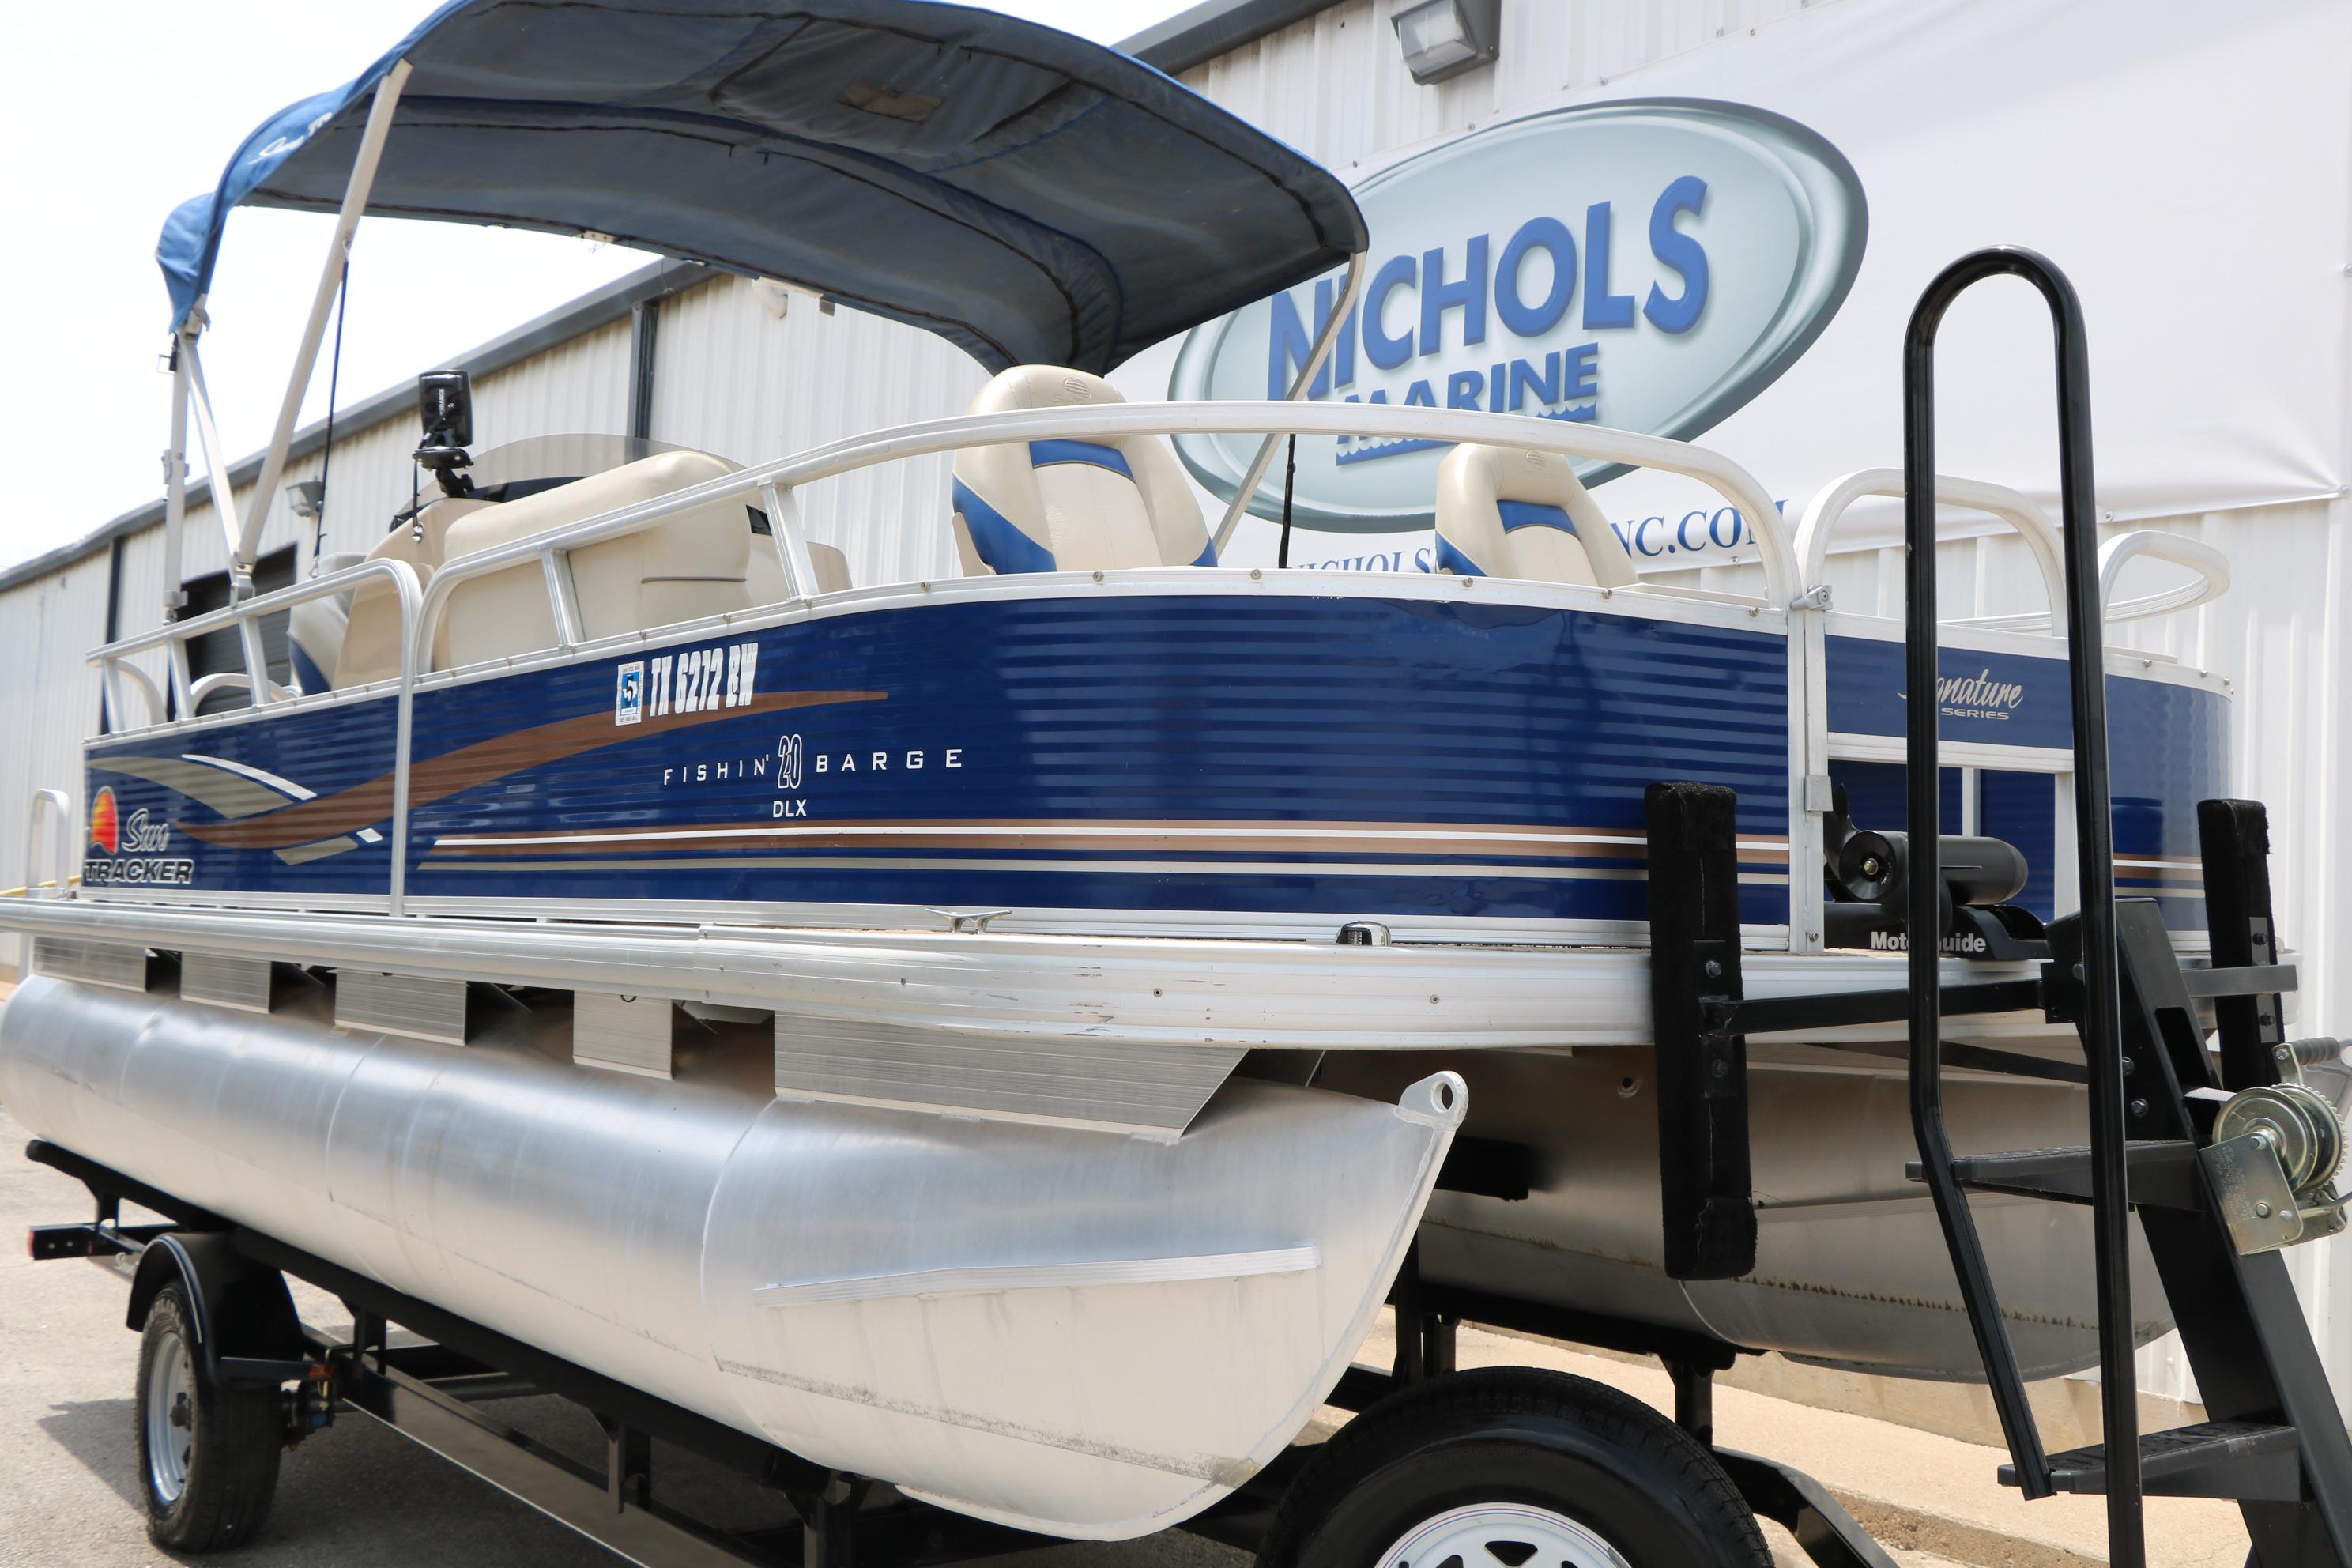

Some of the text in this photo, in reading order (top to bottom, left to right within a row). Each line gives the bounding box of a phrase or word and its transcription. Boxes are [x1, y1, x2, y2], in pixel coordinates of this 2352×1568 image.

[1267, 175, 1709, 401] NICHOLS
[650, 655, 673, 717] TX
[674, 647, 723, 714] 6272
[725, 642, 759, 708] BW
[1940, 707, 2011, 720] SERIES
[664, 733, 963, 789] FISHIN' 20 BARGE
[772, 799, 807, 818] DLX
[121, 808, 171, 853] Sun
[83, 858, 195, 885] TRACKER
[1870, 931, 1988, 953] Motuide
